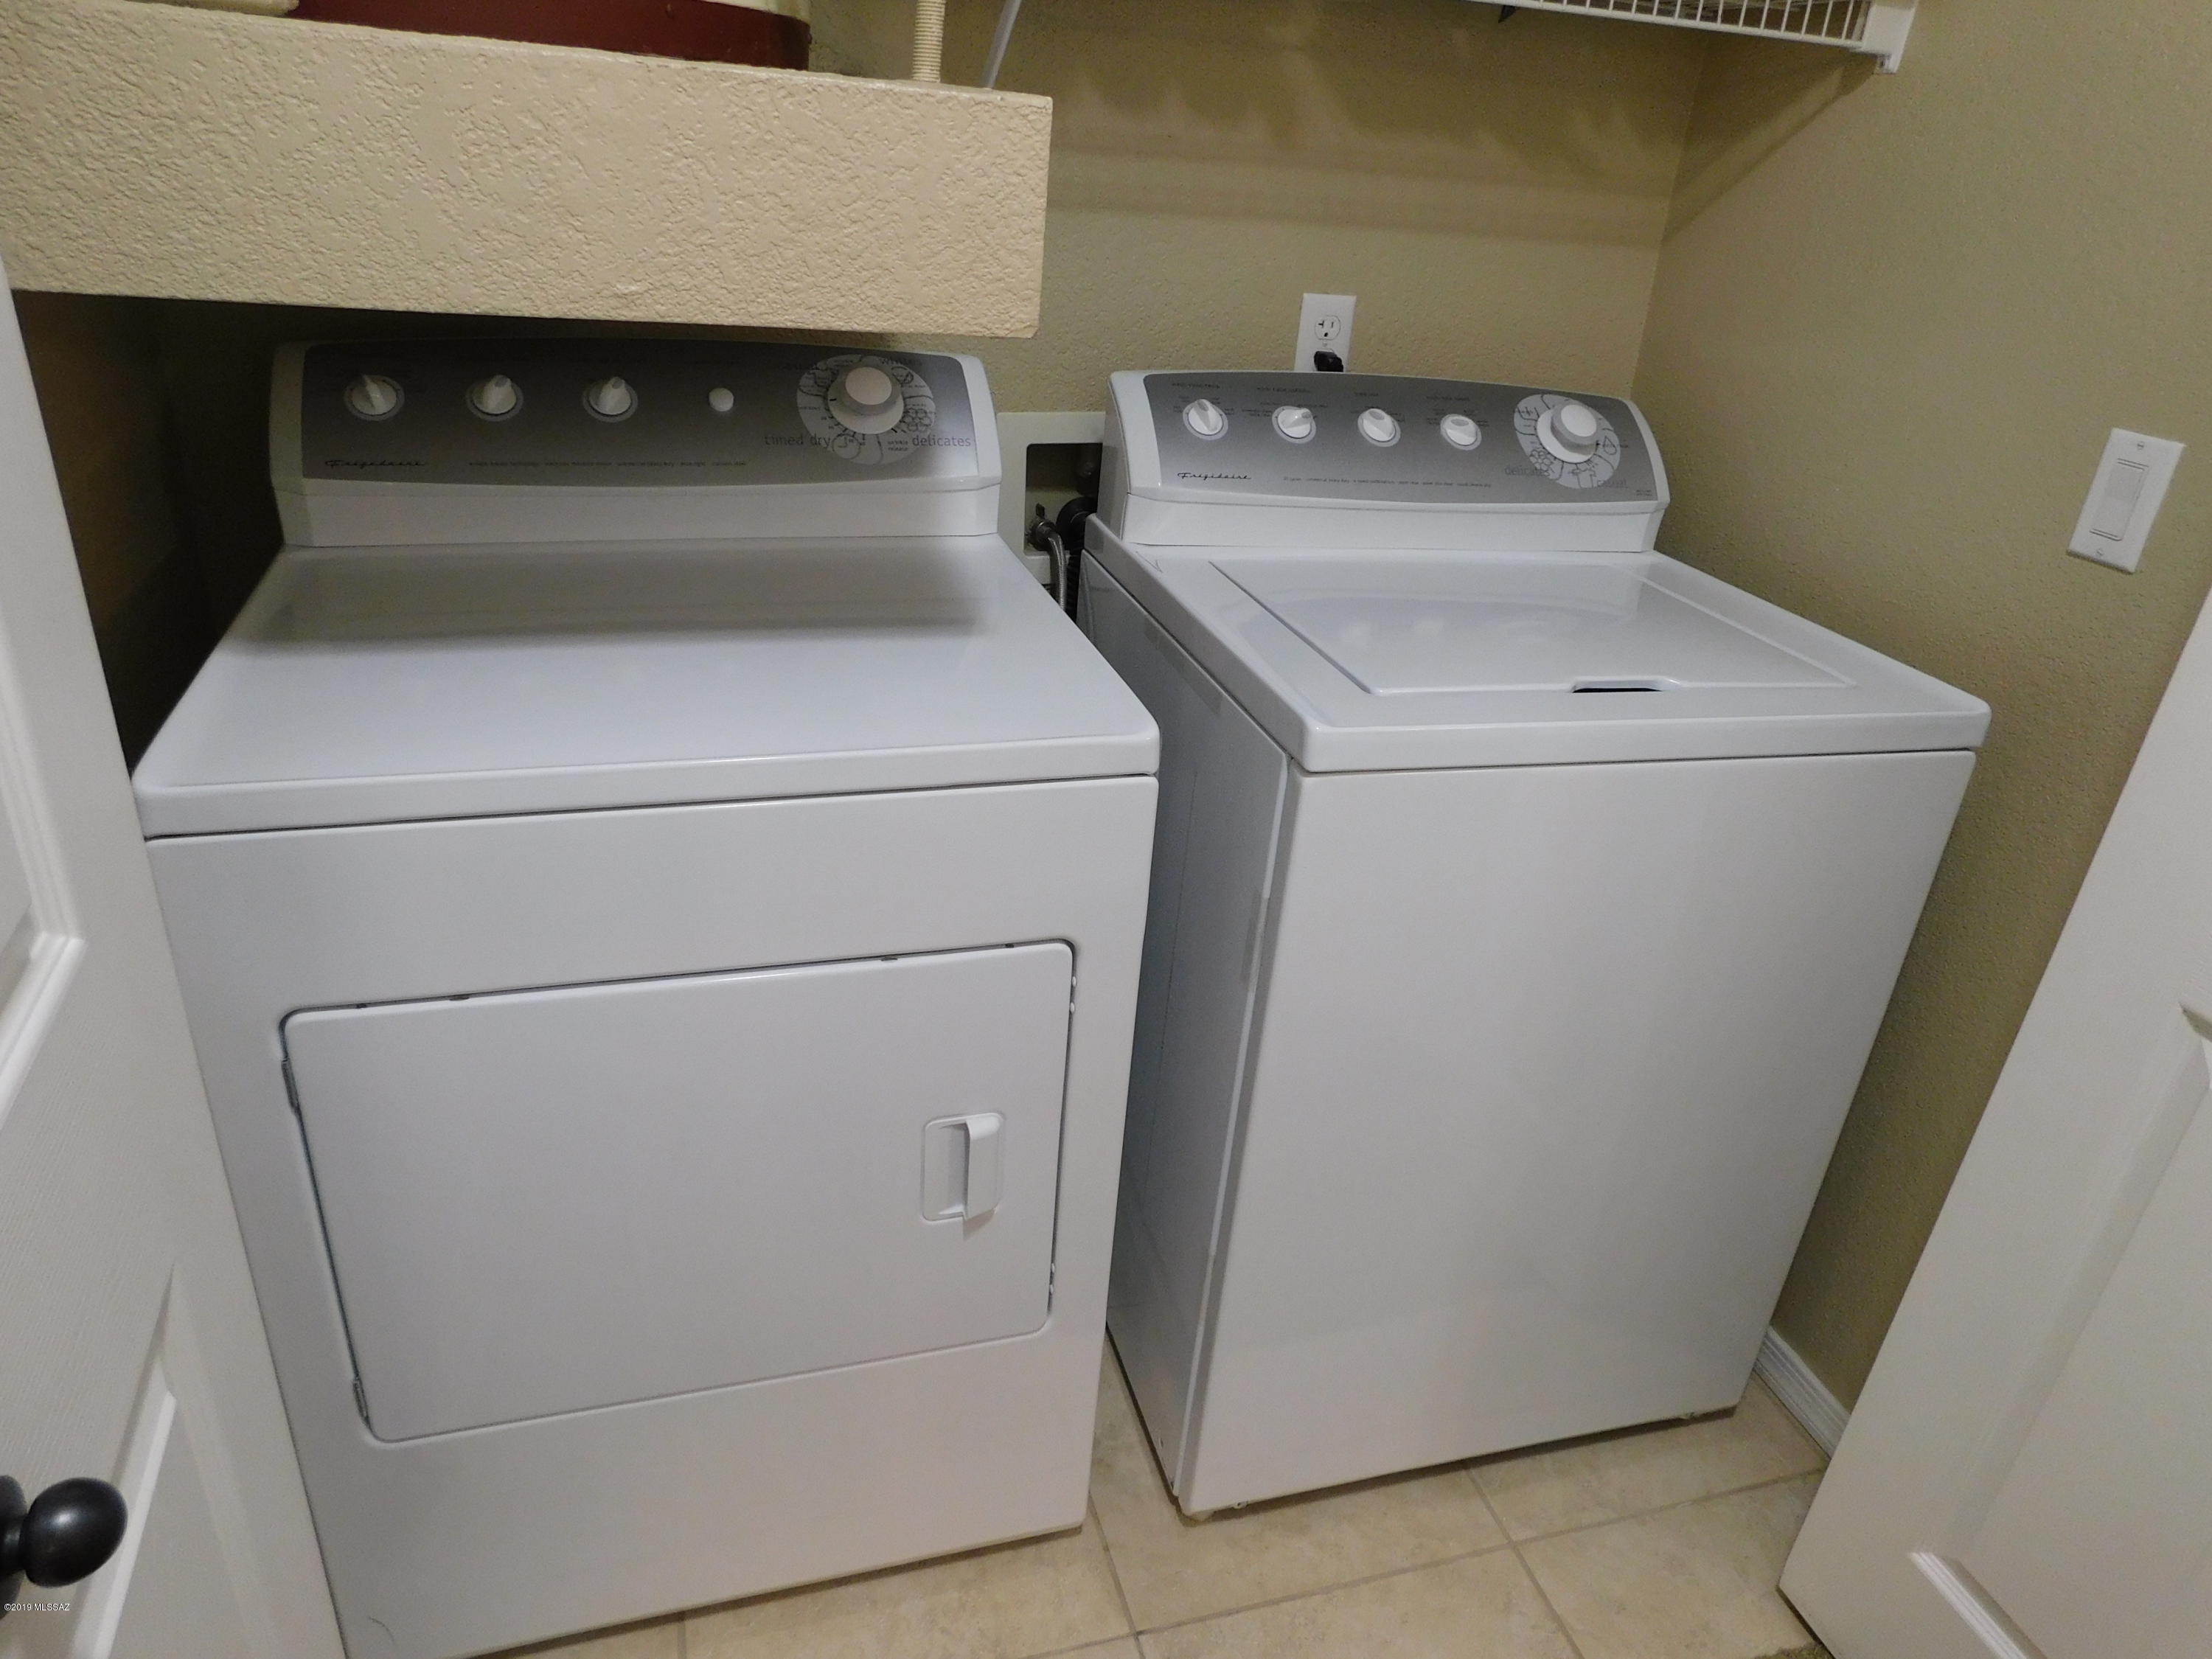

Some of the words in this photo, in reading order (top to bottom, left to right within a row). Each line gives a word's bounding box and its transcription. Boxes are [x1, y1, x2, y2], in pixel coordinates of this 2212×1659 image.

[764, 434, 804, 446] timed
[810, 433, 831, 449] dry
[911, 434, 972, 447] delicates
[1177, 471, 1252, 481] Frigidaire
